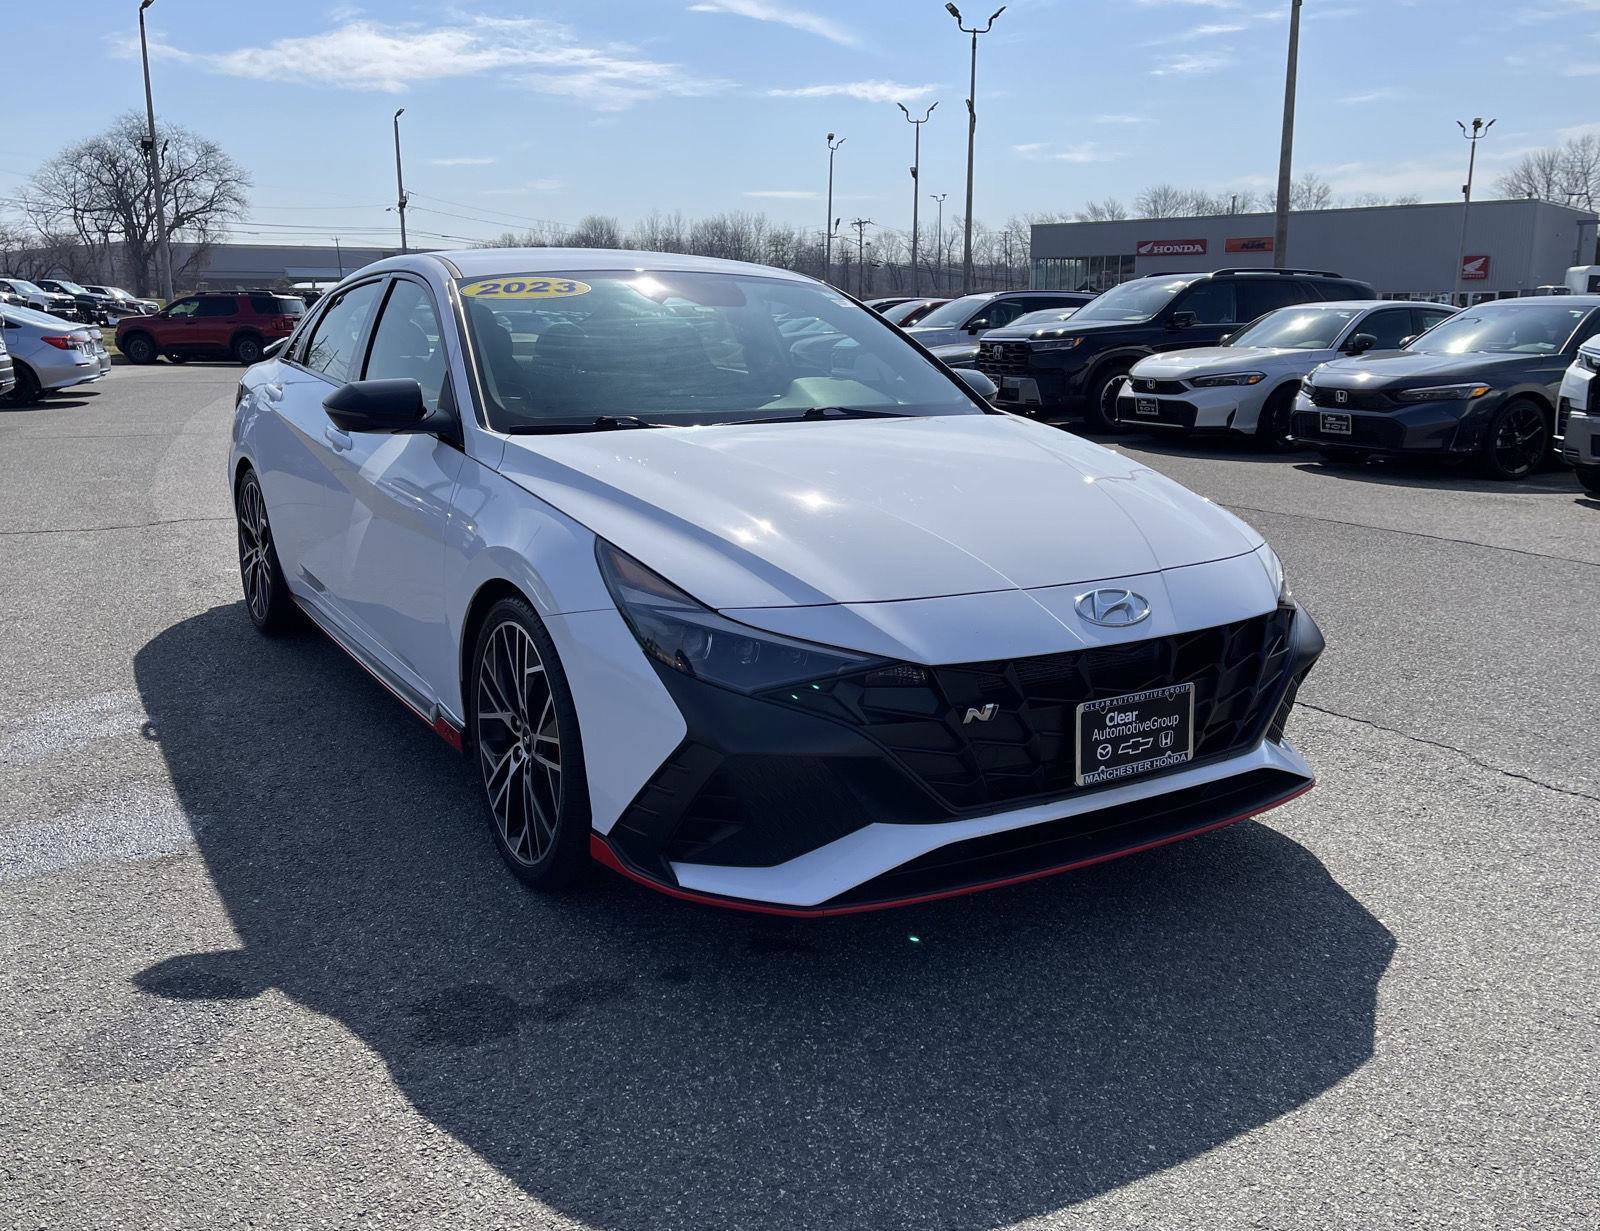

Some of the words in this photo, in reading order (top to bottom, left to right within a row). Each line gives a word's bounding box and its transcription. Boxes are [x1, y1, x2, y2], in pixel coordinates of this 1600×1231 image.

[1152, 244, 1203, 253] HONDA
[475, 281, 577, 295] 2023
[1084, 701, 1111, 711] CLEAR
[1112, 690, 1163, 706] AUTOMOTIVE
[1164, 685, 1190, 696] GROUP
[1092, 714, 1180, 742] AutomotiveGroup
[1105, 710, 1139, 726] Clear
[1085, 761, 1151, 784] MANCHESTER
[1153, 753, 1187, 768] HONDA
